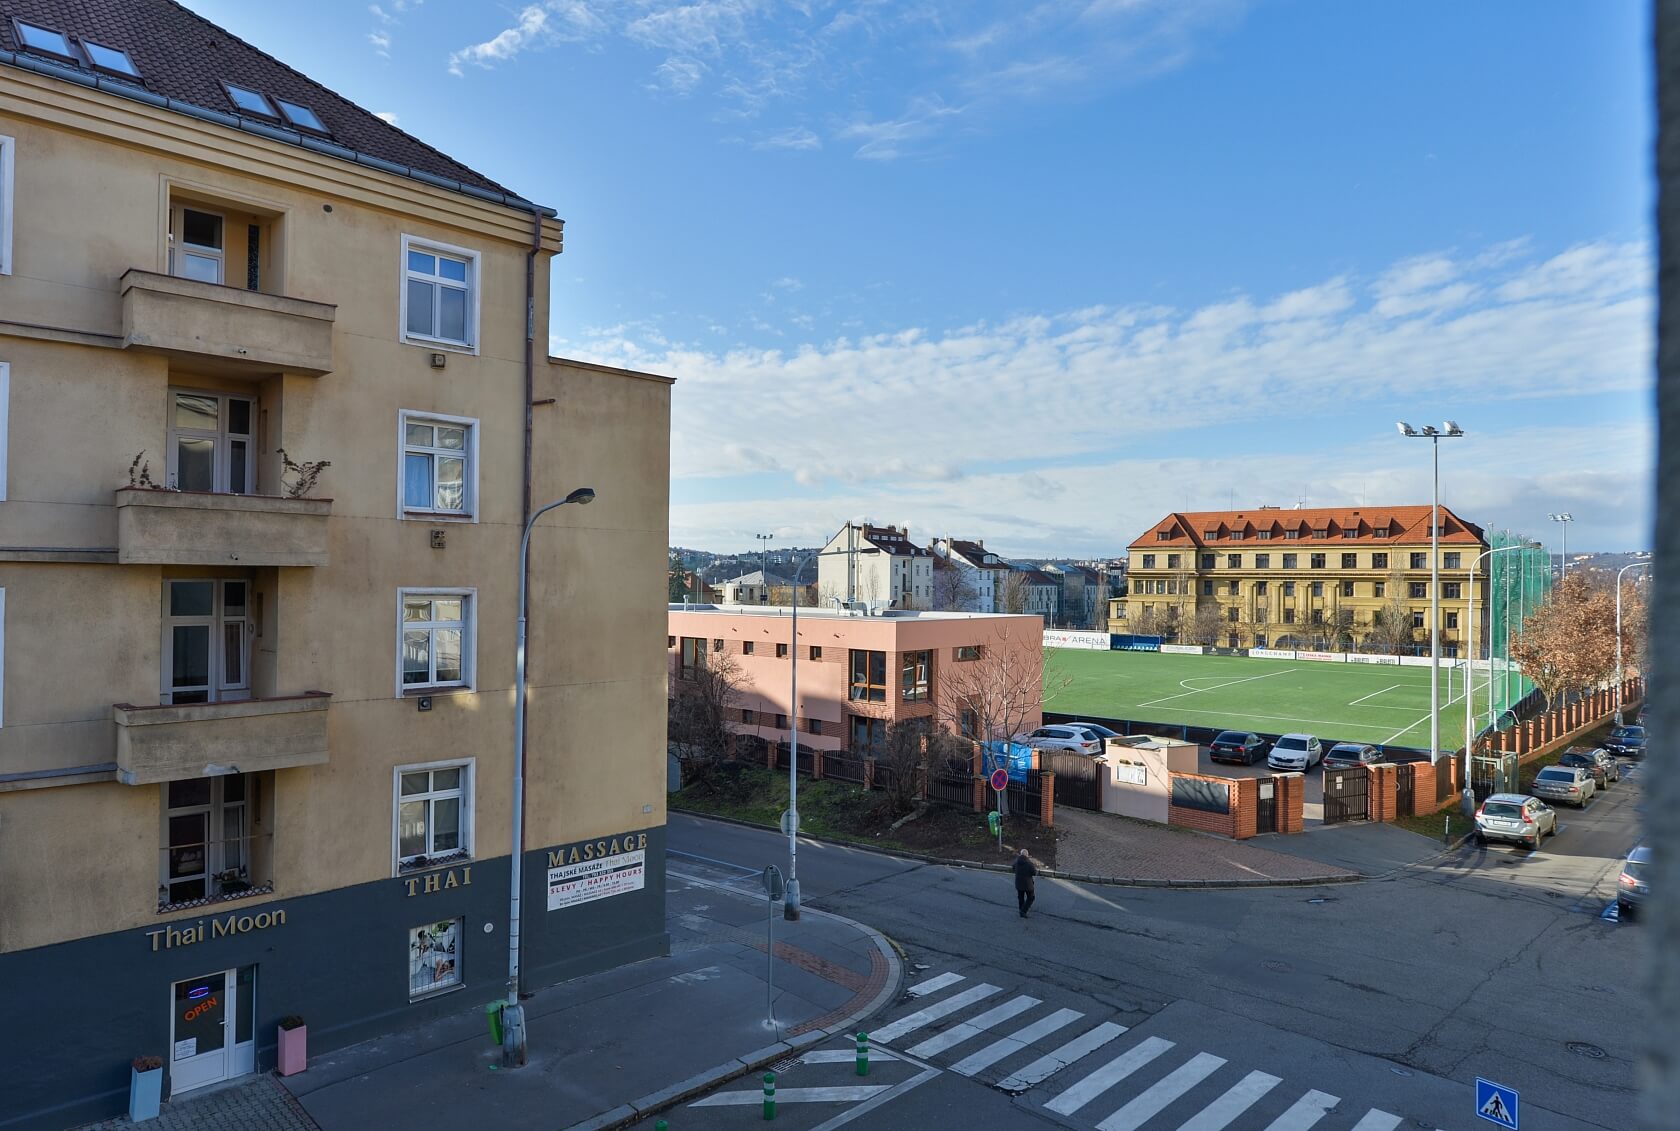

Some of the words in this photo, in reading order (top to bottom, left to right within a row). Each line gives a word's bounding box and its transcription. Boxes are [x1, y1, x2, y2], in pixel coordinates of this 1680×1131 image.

[1072, 636, 1105, 646] ARENA
[547, 833, 647, 868] MASSAGE
[404, 867, 472, 897] THAI
[550, 868, 577, 880] THAJSKÉ
[550, 883, 577, 895] SLEVY
[587, 875, 614, 886] HAPPY
[616, 868, 642, 879] HOURS
[145, 920, 204, 951] Thai
[211, 909, 287, 939] Moon
[183, 996, 218, 1022] OPEN
